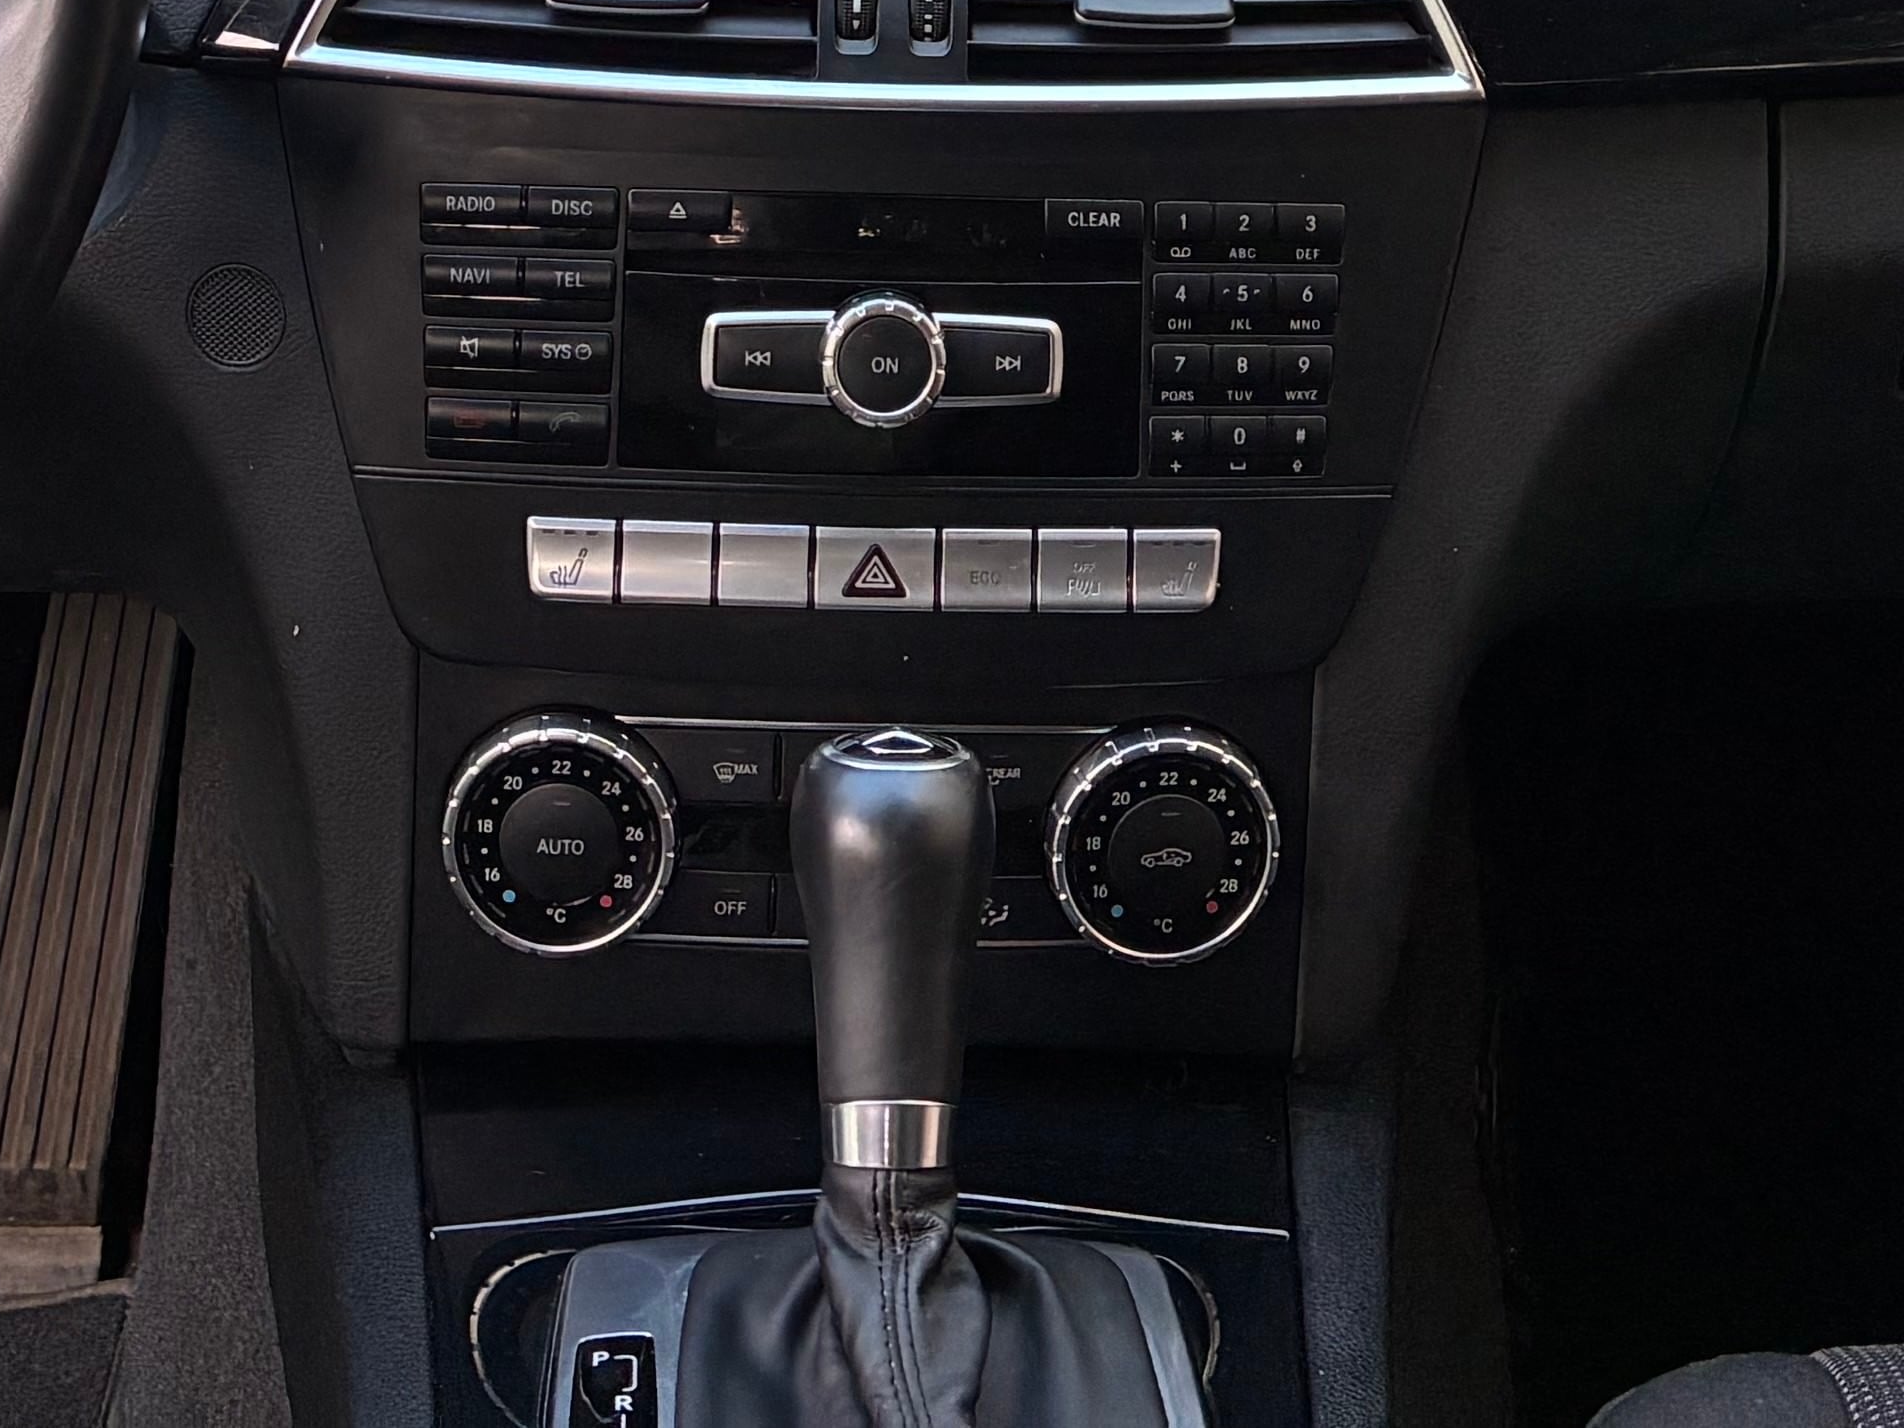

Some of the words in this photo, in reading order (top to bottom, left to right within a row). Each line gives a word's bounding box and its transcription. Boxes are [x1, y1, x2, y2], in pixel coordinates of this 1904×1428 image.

[446, 196, 496, 212] RADIO
[551, 199, 593, 216] DISC
[1067, 211, 1121, 228] CLEAR
[1179, 213, 1187, 231] 1
[1239, 214, 1251, 232] 2
[1305, 215, 1317, 232] 3
[1228, 247, 1257, 260] ABC
[1295, 248, 1321, 260] DEF
[450, 267, 490, 284] NAVI
[554, 271, 585, 288] TEL
[1175, 285, 1187, 303] 4
[1236, 285, 1249, 302] 5
[1302, 285, 1314, 303] 6
[1167, 318, 1192, 331] GHI
[1229, 319, 1253, 331] JKL
[1289, 319, 1321, 331] MNO
[541, 343, 572, 360] SYS
[871, 356, 899, 374] ON
[1174, 356, 1186, 373] 7
[1237, 356, 1249, 374] 8
[1298, 356, 1311, 373] 9
[1161, 390, 1195, 402] PQRS
[1227, 390, 1253, 402] TUV
[1285, 389, 1319, 401] WXYZ
[1233, 427, 1246, 445] 0
[968, 570, 1001, 585] ECO
[551, 760, 572, 775] 22
[735, 763, 758, 776] MAX
[994, 767, 1021, 779] REAR
[503, 775, 523, 791] 20
[1159, 772, 1178, 786] 22
[601, 781, 621, 796] 24
[1207, 788, 1227, 803] 24
[1111, 791, 1130, 806] 20
[477, 819, 493, 833] 18
[625, 826, 644, 842] 26
[1085, 837, 1101, 851] 18
[1230, 830, 1249, 846] 26
[536, 838, 584, 855] AUTO
[484, 867, 500, 882] 16
[613, 874, 633, 889] 28
[1092, 883, 1108, 899] 16
[1219, 878, 1238, 893] 28
[713, 900, 747, 916] OFF
[591, 1350, 610, 1367] P
[614, 1395, 634, 1411] R
